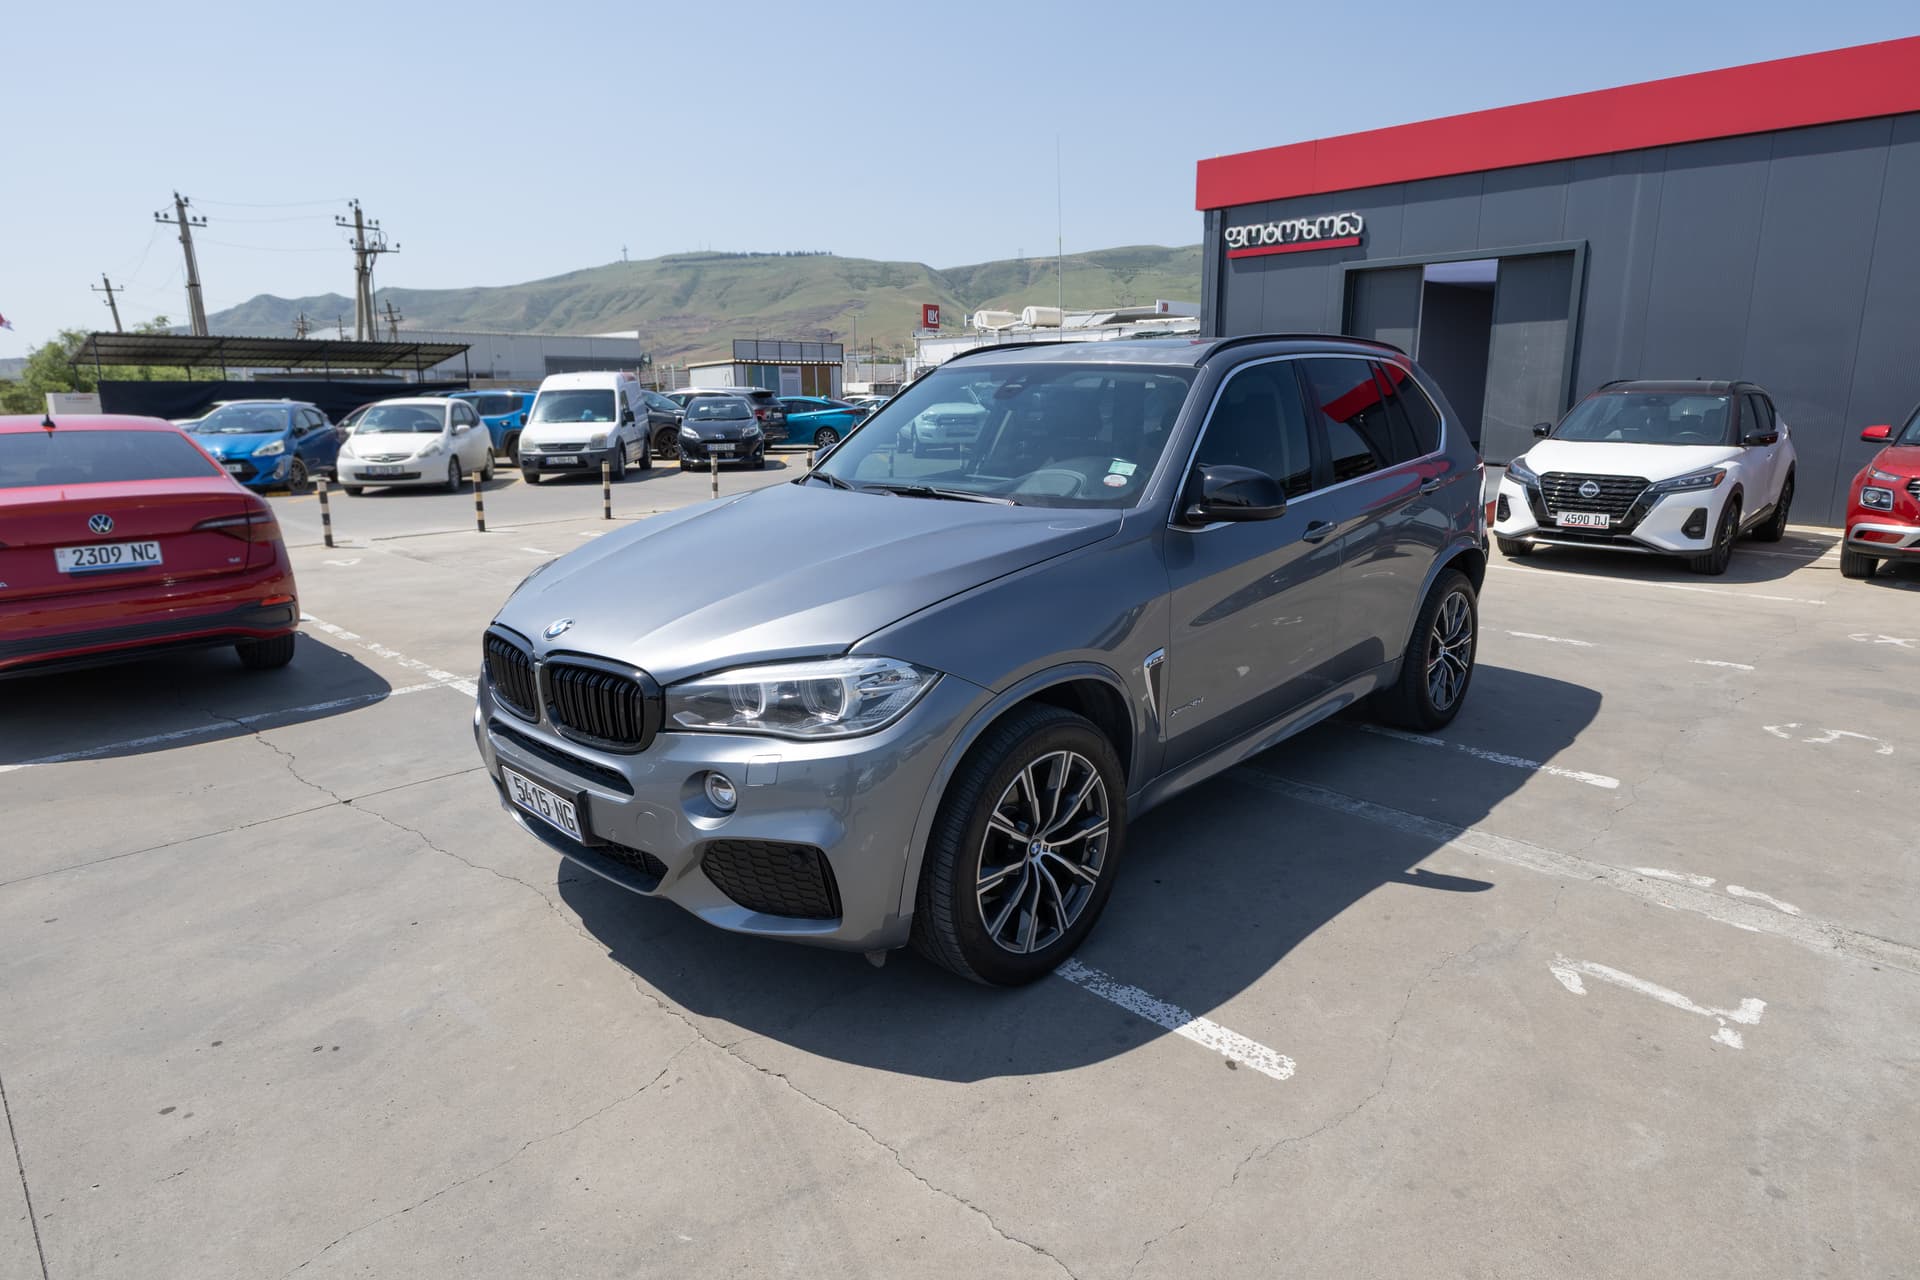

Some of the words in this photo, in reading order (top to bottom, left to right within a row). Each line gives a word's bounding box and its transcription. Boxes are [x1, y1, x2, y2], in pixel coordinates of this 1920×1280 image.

[1225, 212, 1363, 248] ფოტოზონა
[1564, 513, 1590, 525] 4590
[1594, 515, 1608, 526] DJ
[72, 546, 122, 566] 2309
[131, 543, 158, 561] NC
[513, 775, 551, 817] 5415
[553, 797, 577, 832] NG
